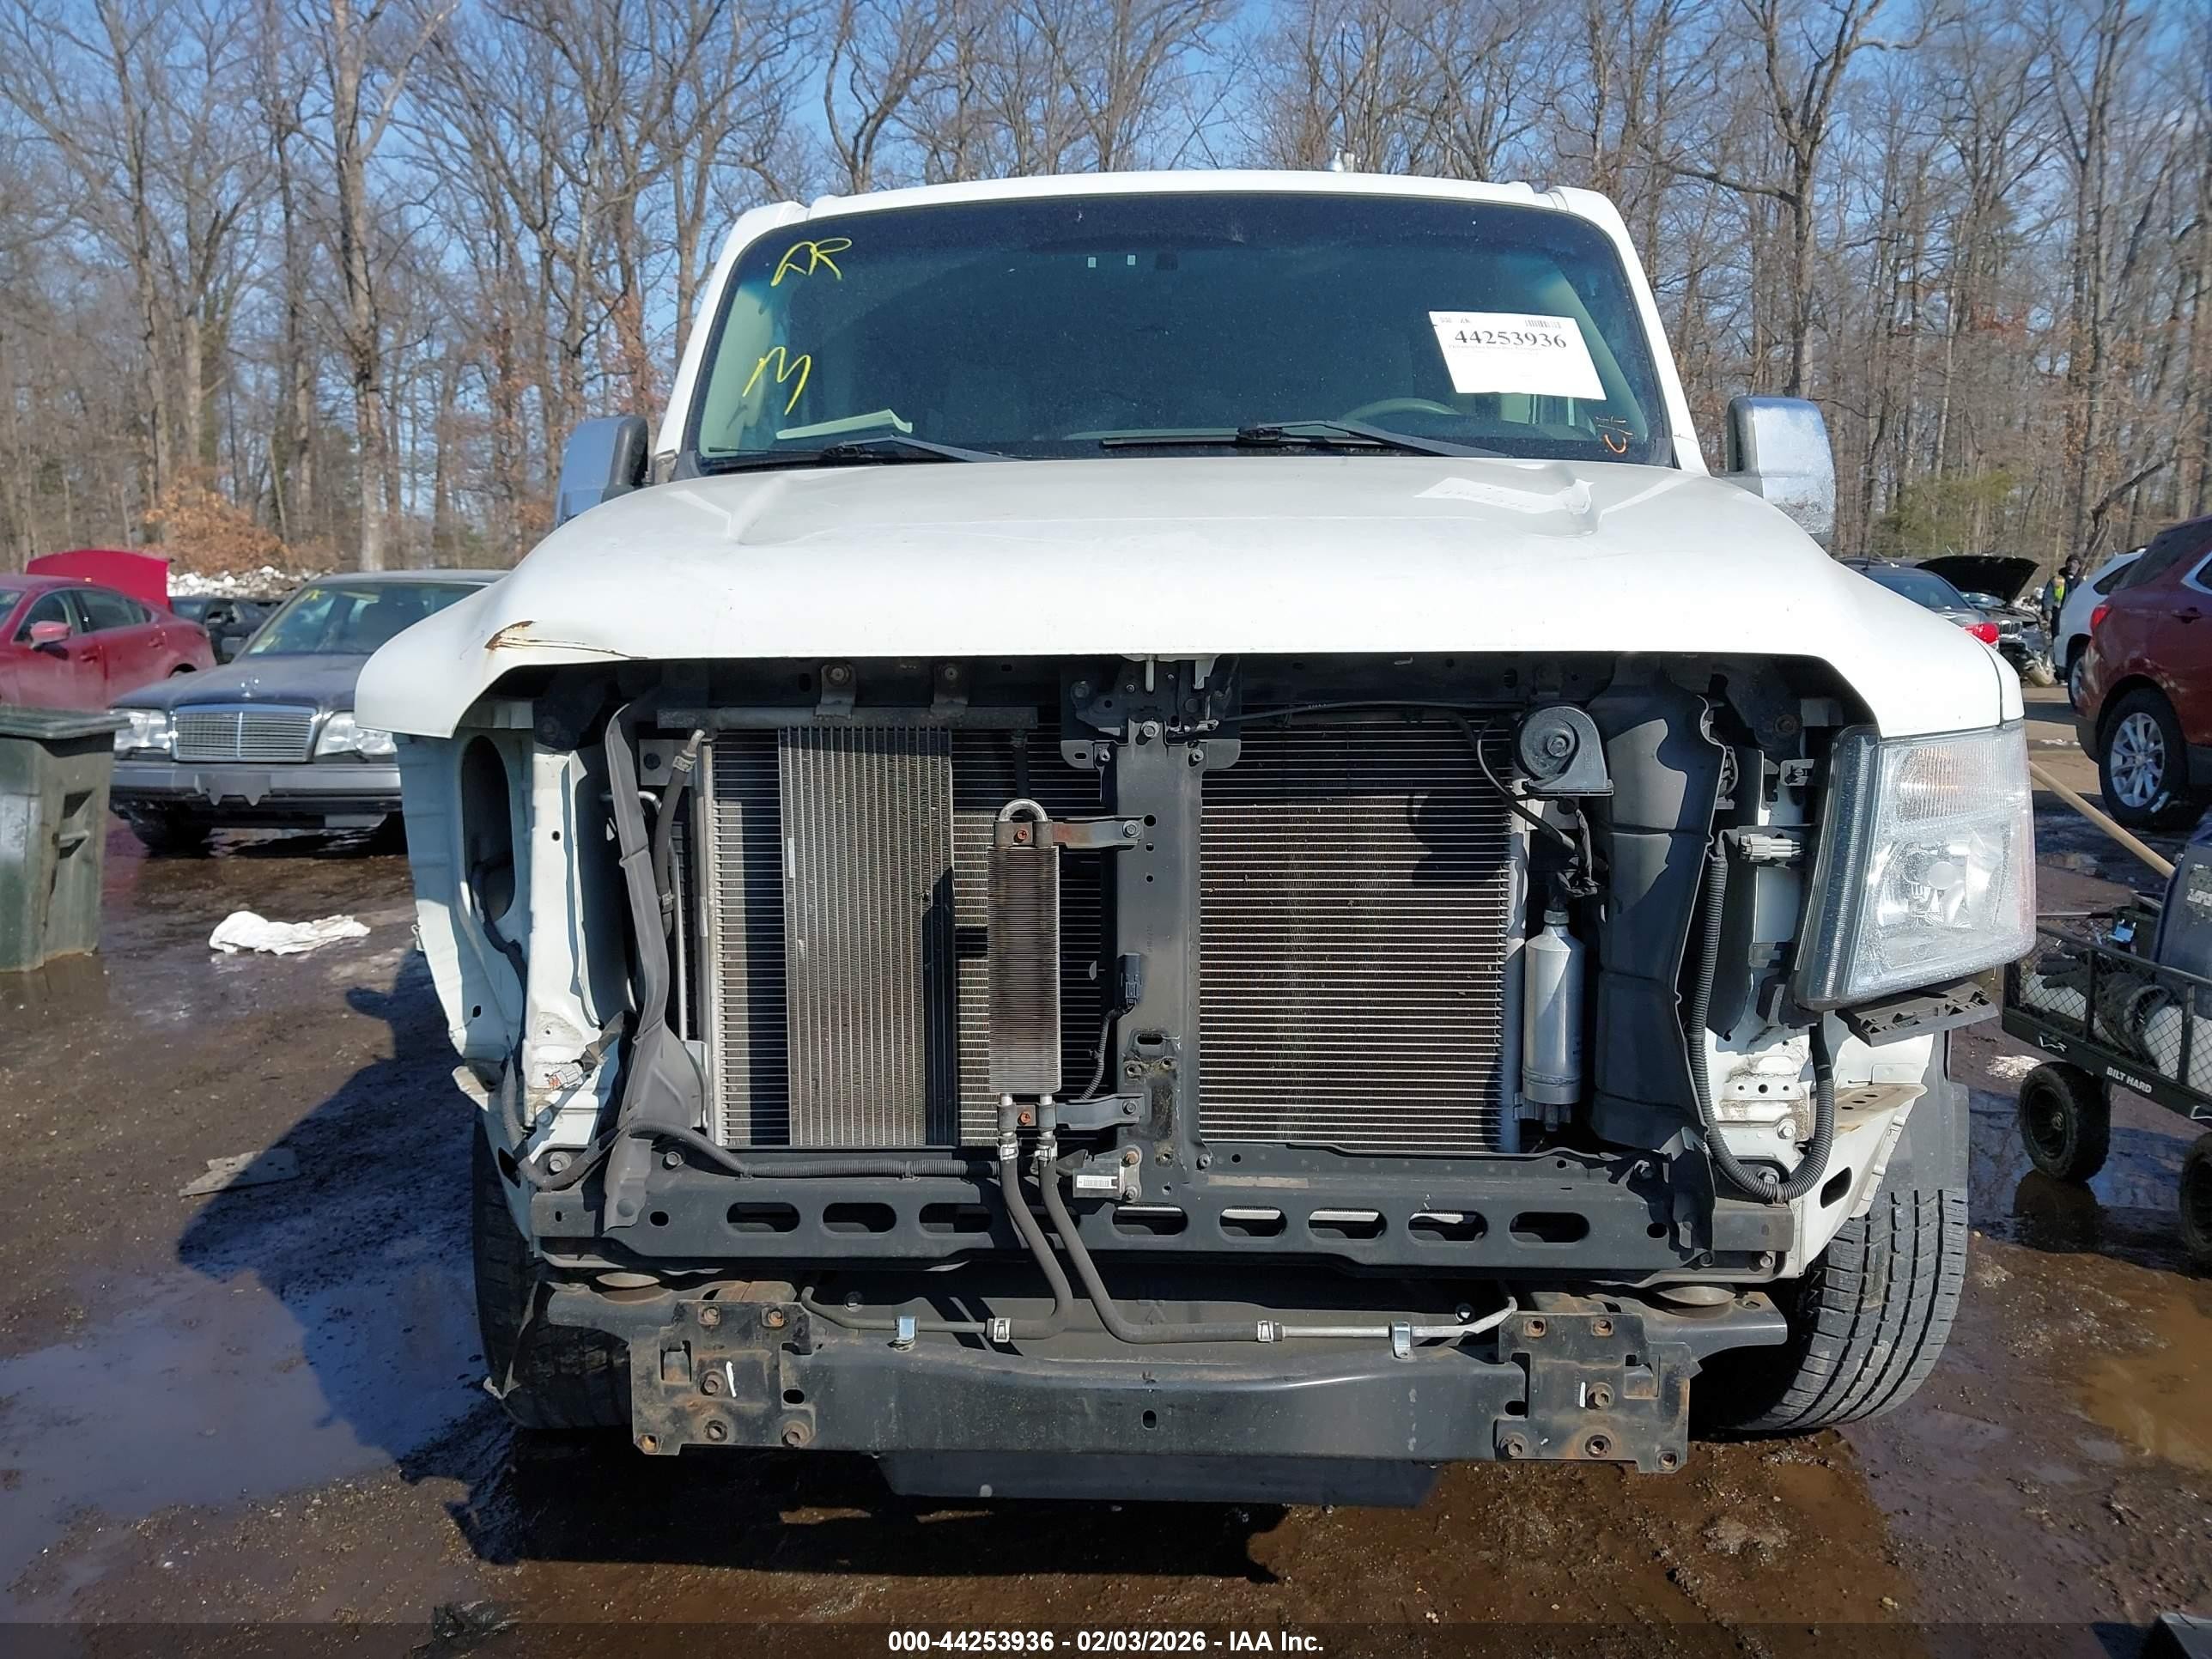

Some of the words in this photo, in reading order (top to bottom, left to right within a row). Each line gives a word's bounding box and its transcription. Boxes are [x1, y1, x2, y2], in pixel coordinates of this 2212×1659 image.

[1455, 330, 1567, 349] 44253936
[2106, 1066, 2126, 1081] BILT
[2126, 1075, 2153, 1094] HARD
